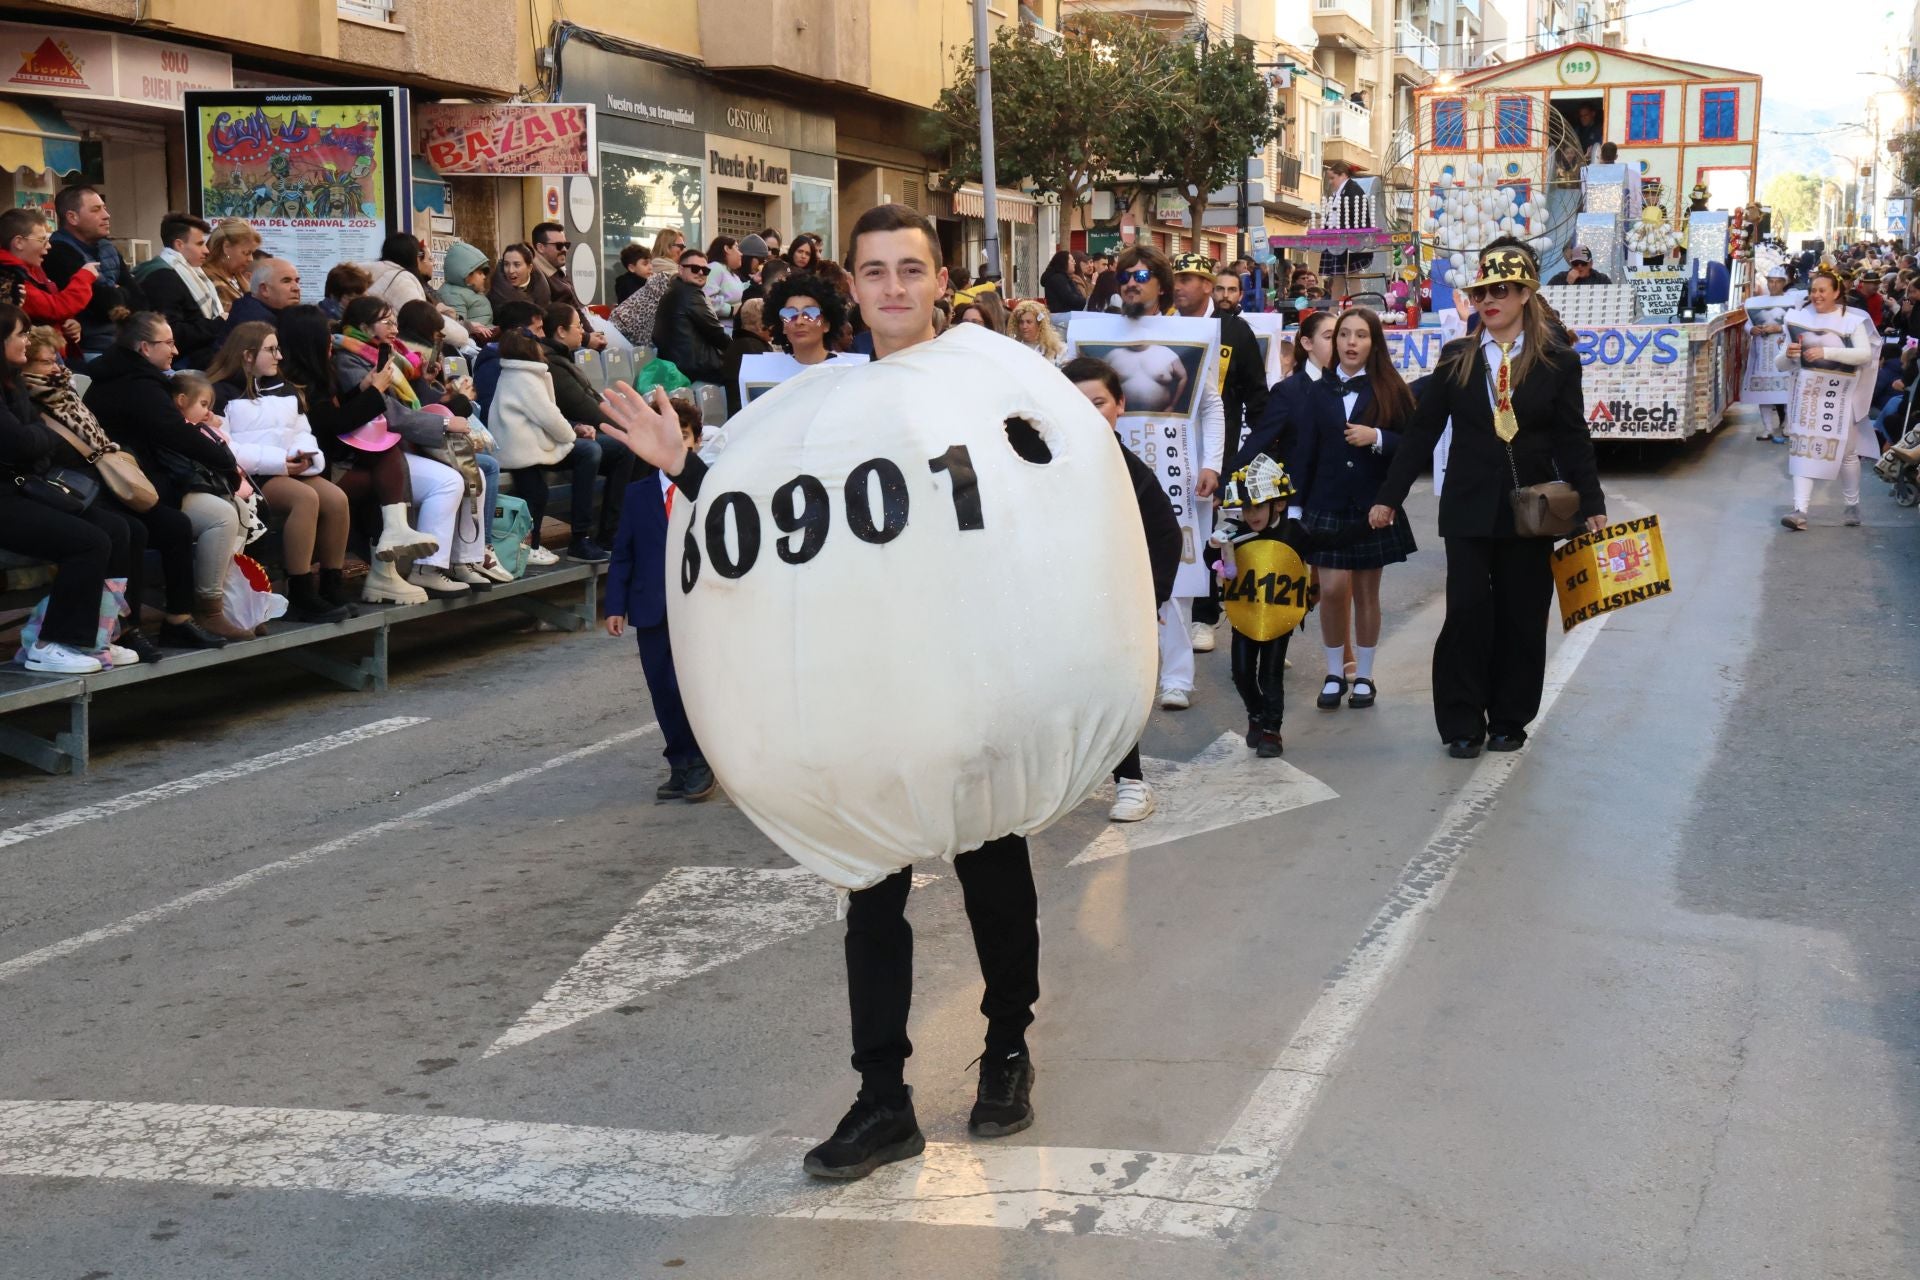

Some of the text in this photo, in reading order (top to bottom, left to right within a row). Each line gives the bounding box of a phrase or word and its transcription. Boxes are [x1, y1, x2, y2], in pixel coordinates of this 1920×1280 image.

[161, 50, 189, 74] SOLO
[1565, 61, 1592, 74] 1989
[142, 76, 172, 100] BUEN
[607, 94, 695, 125] Nuestro reto, su tranquilidad
[727, 107, 773, 134] GESTORÍA
[429, 107, 582, 169] BAZAR
[709, 150, 788, 185] Puerta de Lorca
[269, 219, 288, 227] DEL
[291, 219, 346, 227] CARNAVAL
[348, 220, 377, 228] 2025
[1648, 307, 1674, 315] MENOS
[1575, 328, 1680, 365] BOYS
[1589, 400, 1678, 422] Alltech
[1821, 379, 1840, 433] 36860
[1144, 423, 1155, 439] EL
[1620, 421, 1677, 433] SCIENCE
[1164, 427, 1183, 517] 36860
[1553, 514, 1658, 561] HACIENDA
[1566, 568, 1589, 591] DE
[1564, 579, 1671, 632] MINISTERIO
